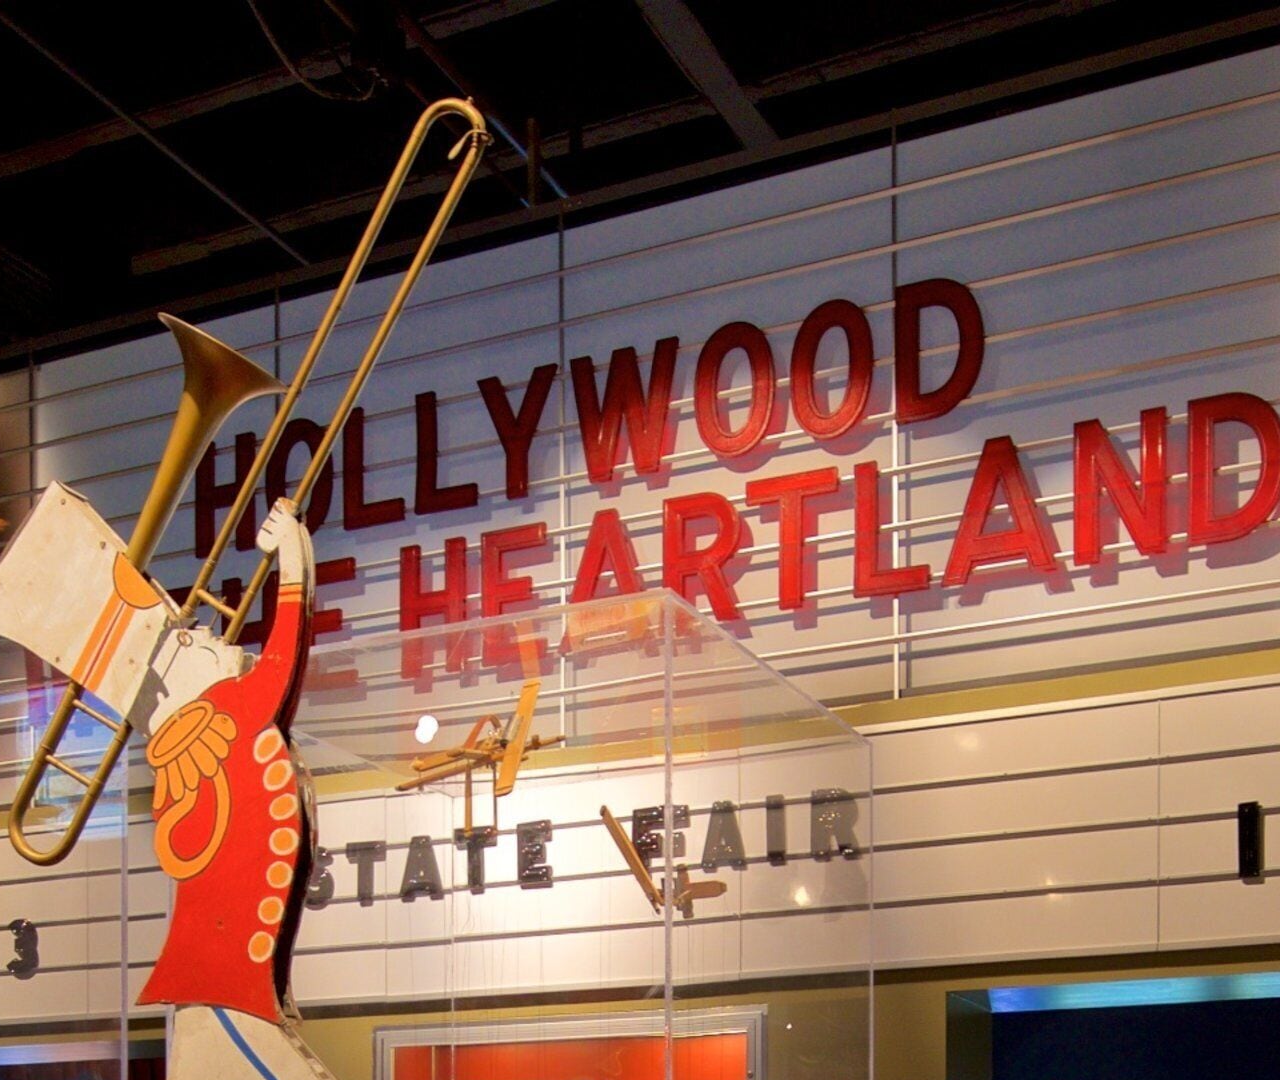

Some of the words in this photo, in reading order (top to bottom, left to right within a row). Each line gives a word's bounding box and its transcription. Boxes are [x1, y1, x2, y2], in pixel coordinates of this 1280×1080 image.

[195, 277, 986, 558] HOLLYWOOD
[305, 819, 553, 911] STATE
[632, 787, 860, 875] FAIR
